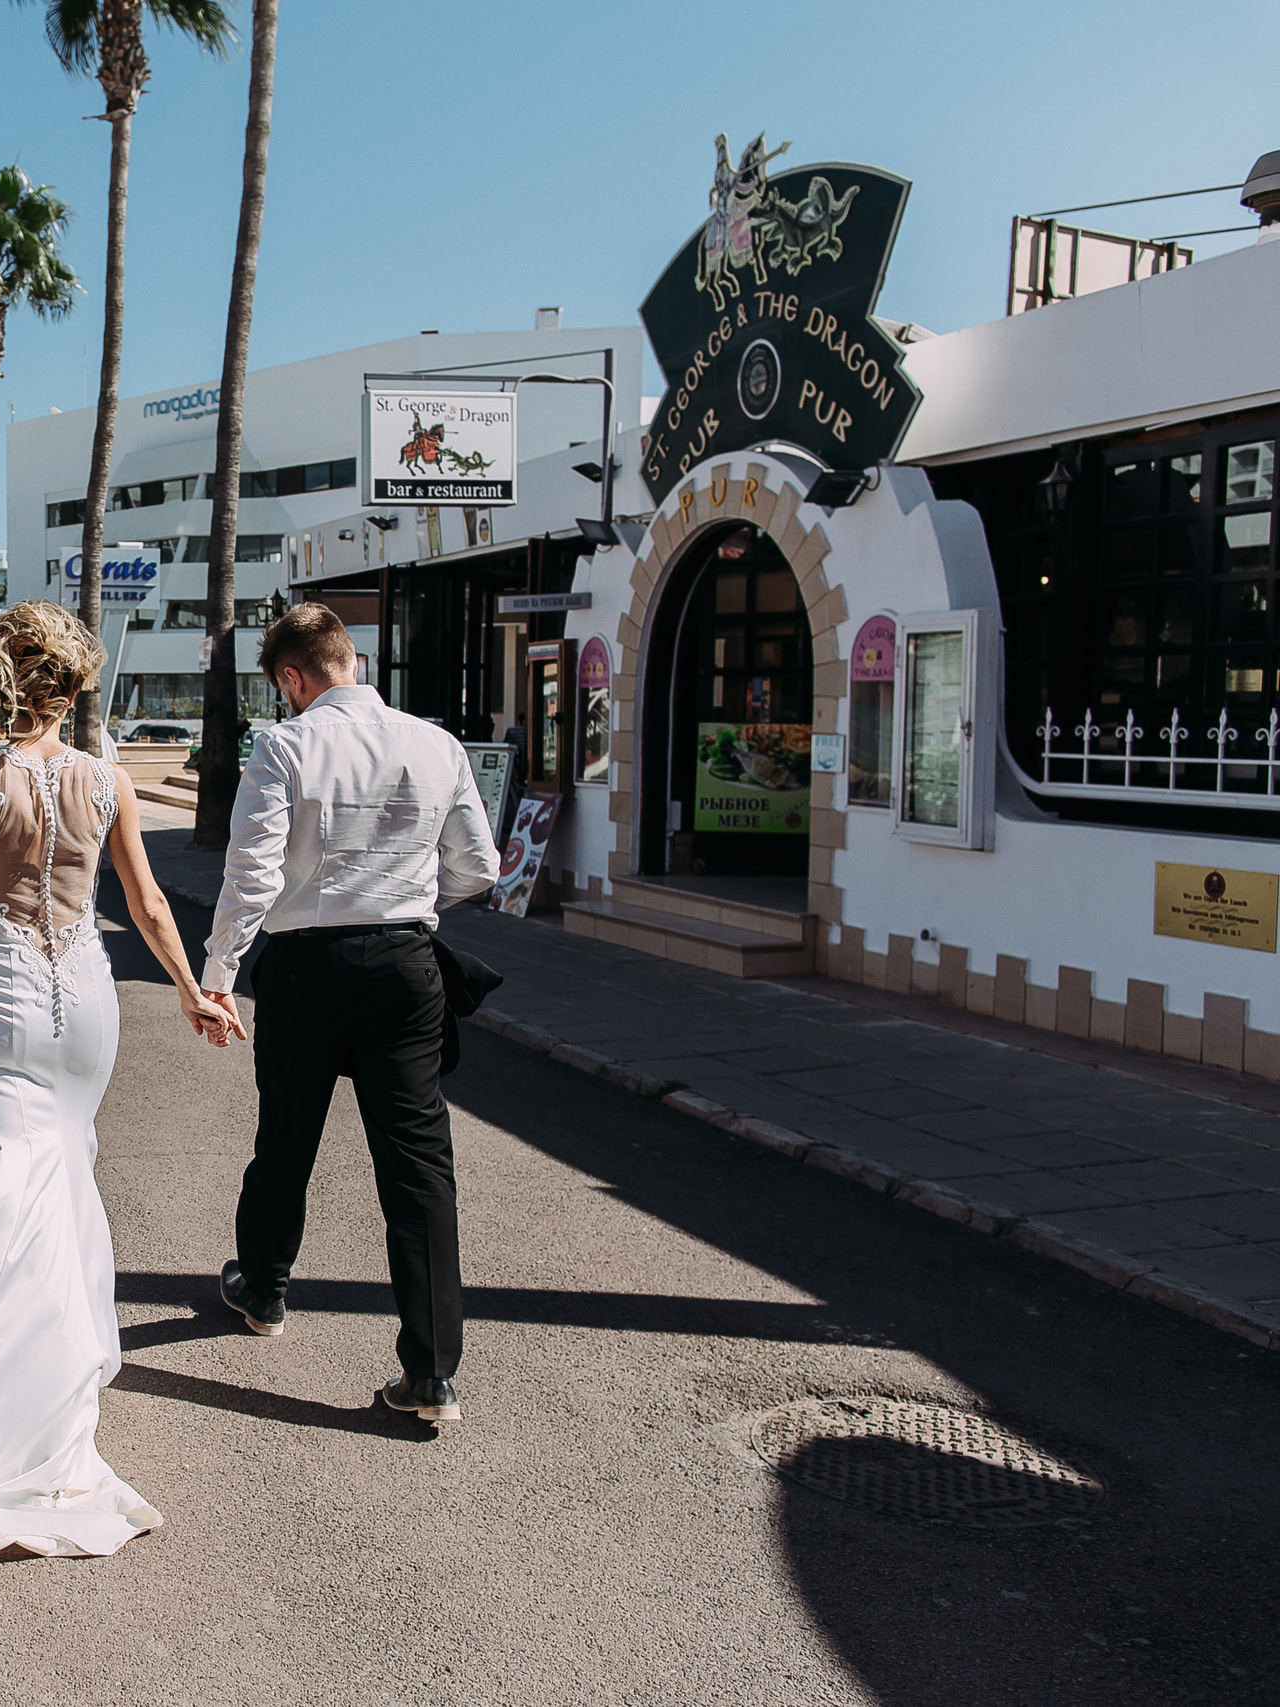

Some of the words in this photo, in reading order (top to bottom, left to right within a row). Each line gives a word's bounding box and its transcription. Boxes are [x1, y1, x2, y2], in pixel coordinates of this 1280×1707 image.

[667, 316, 733, 430] GEORGE
[753, 291, 799, 322] THE
[803, 306, 895, 411] DRAGON
[376, 397, 394, 412] St.
[398, 398, 447, 417] George
[460, 407, 510, 427] Dragon
[798, 379, 853, 443] PUB
[678, 408, 720, 478] PUB
[387, 480, 413, 496] bar
[415, 489, 424, 497] &
[427, 483, 503, 498] restaurant
[65, 553, 157, 581] Crats
[699, 797, 770, 812] РЫБНОЕ
[717, 814, 762, 828] МЕЗЕ
